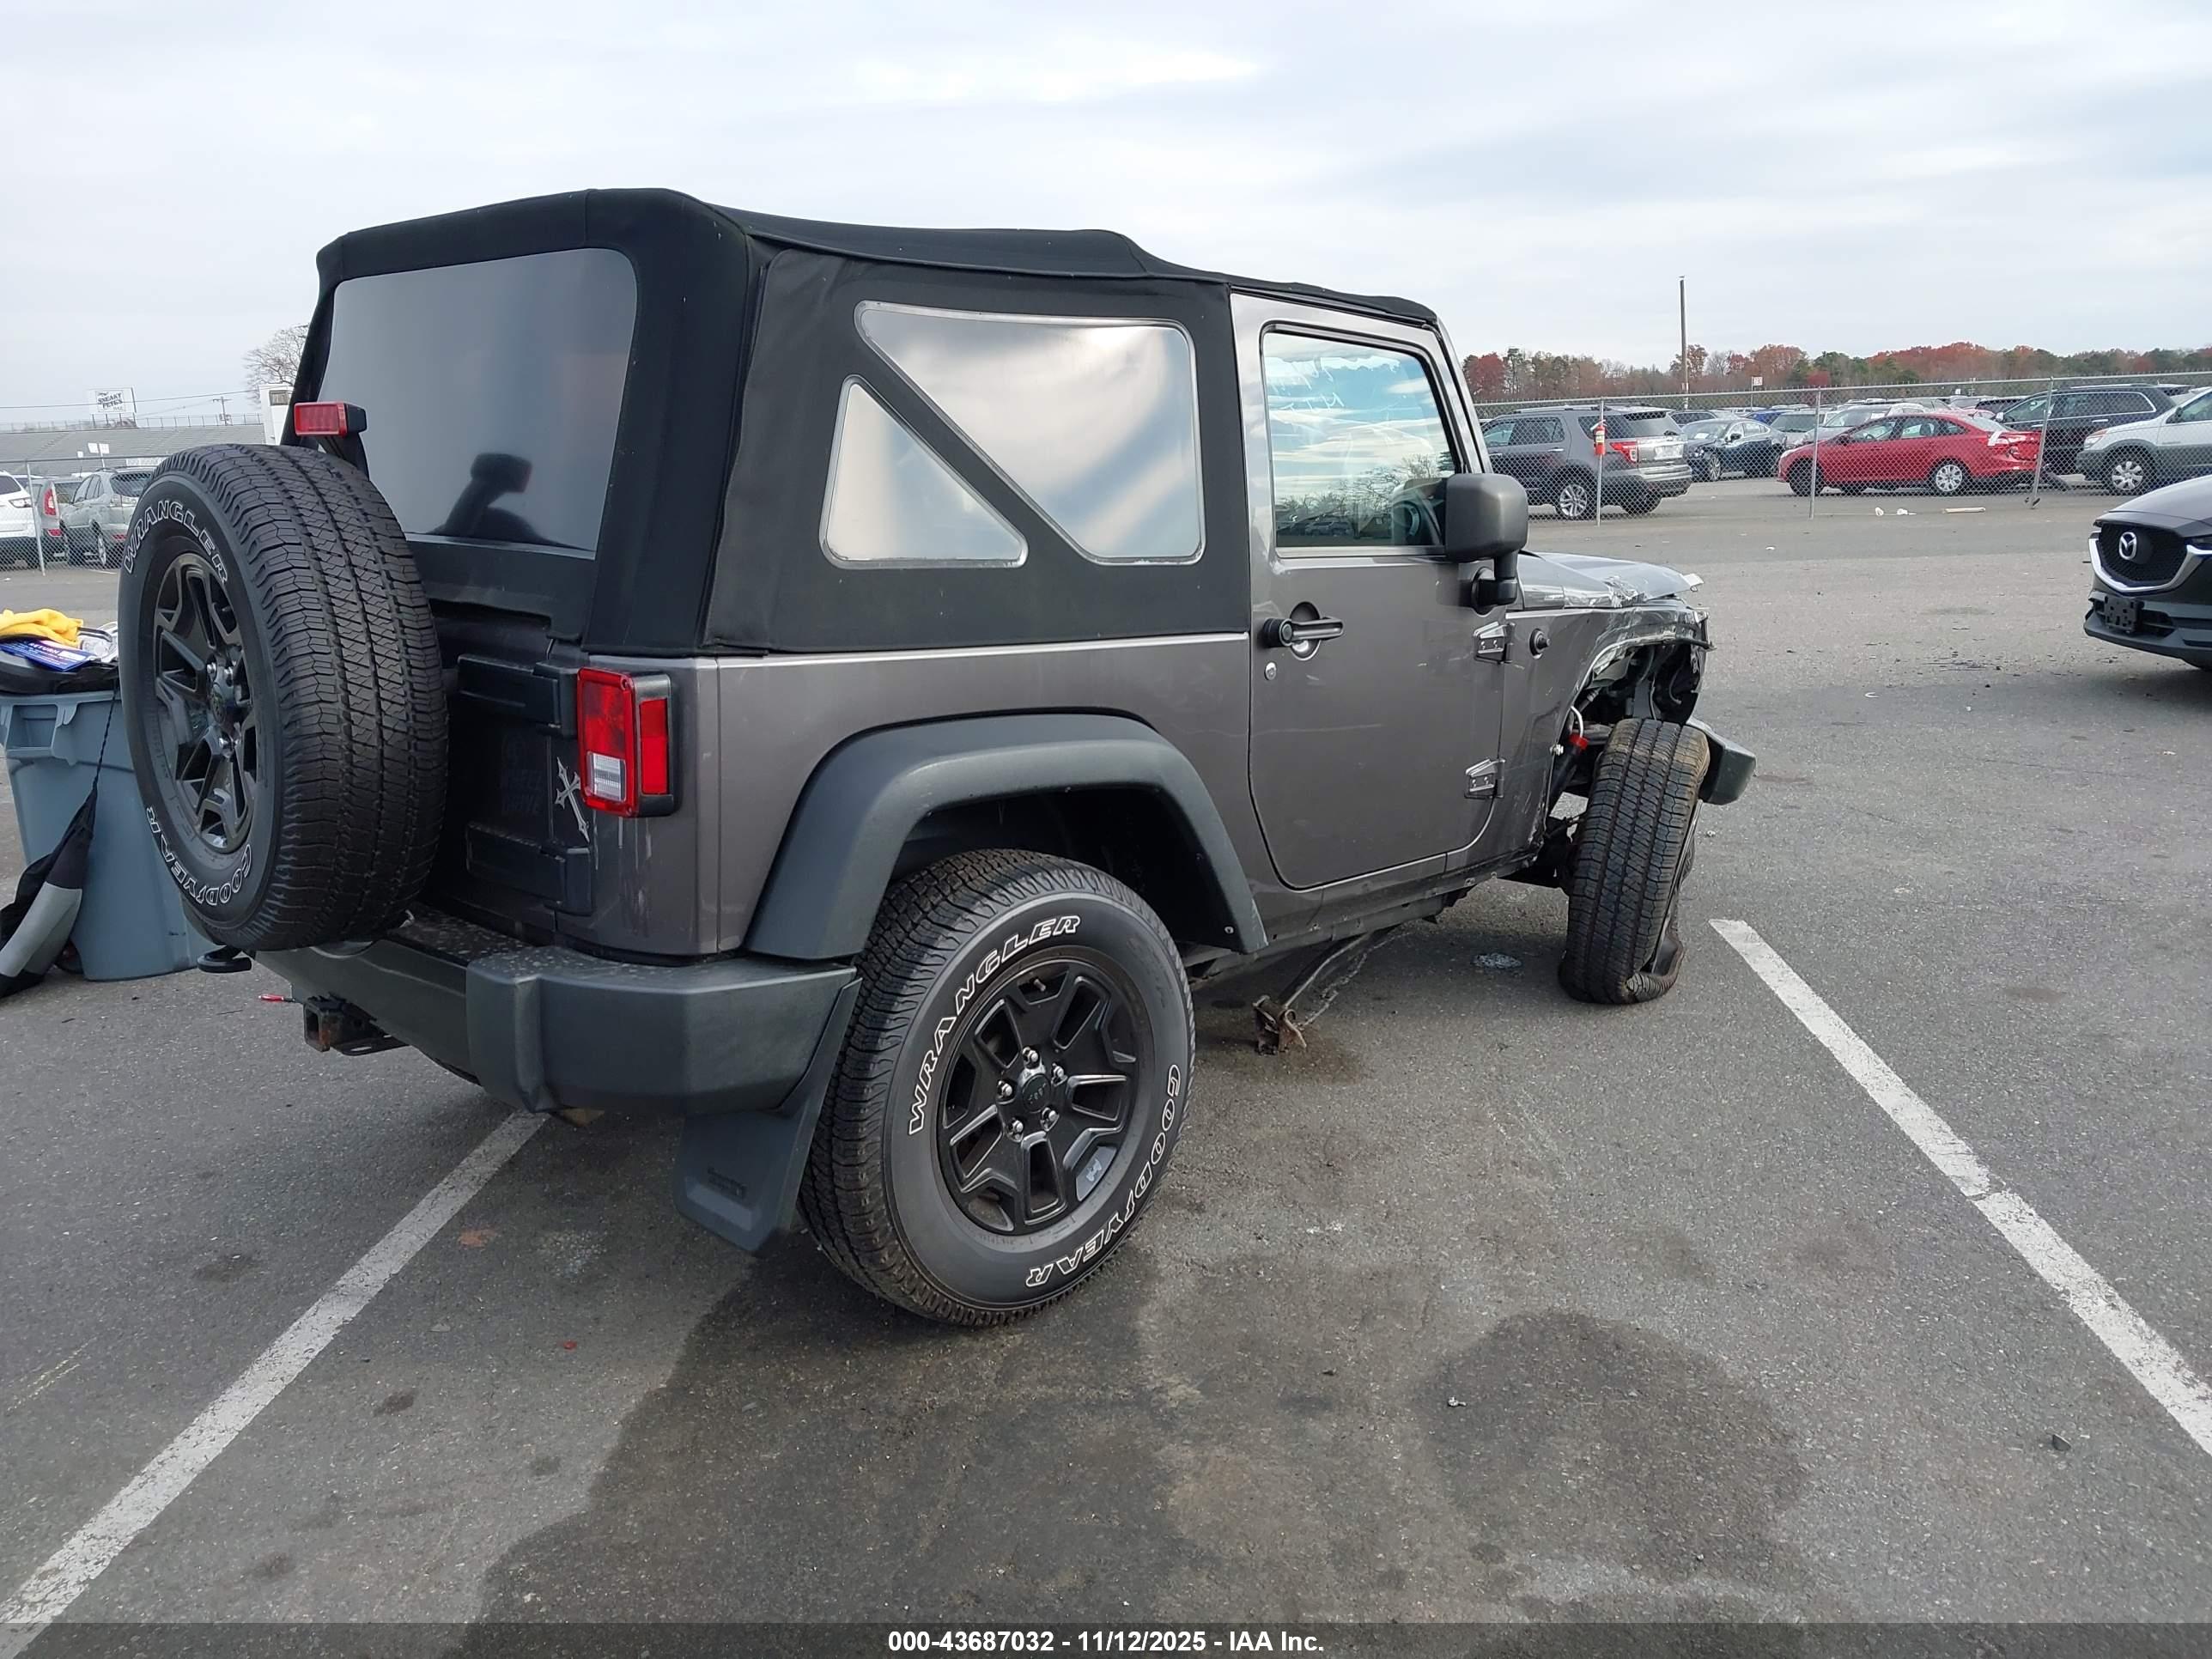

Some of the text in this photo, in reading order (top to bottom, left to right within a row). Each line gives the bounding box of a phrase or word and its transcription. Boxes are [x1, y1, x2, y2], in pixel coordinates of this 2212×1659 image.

[124, 500, 228, 584] WRANGLER
[146, 806, 252, 906] GOODYEAR
[908, 915, 1080, 1134] WRANGLER
[1026, 1064, 1181, 1287] GOODYEAR
